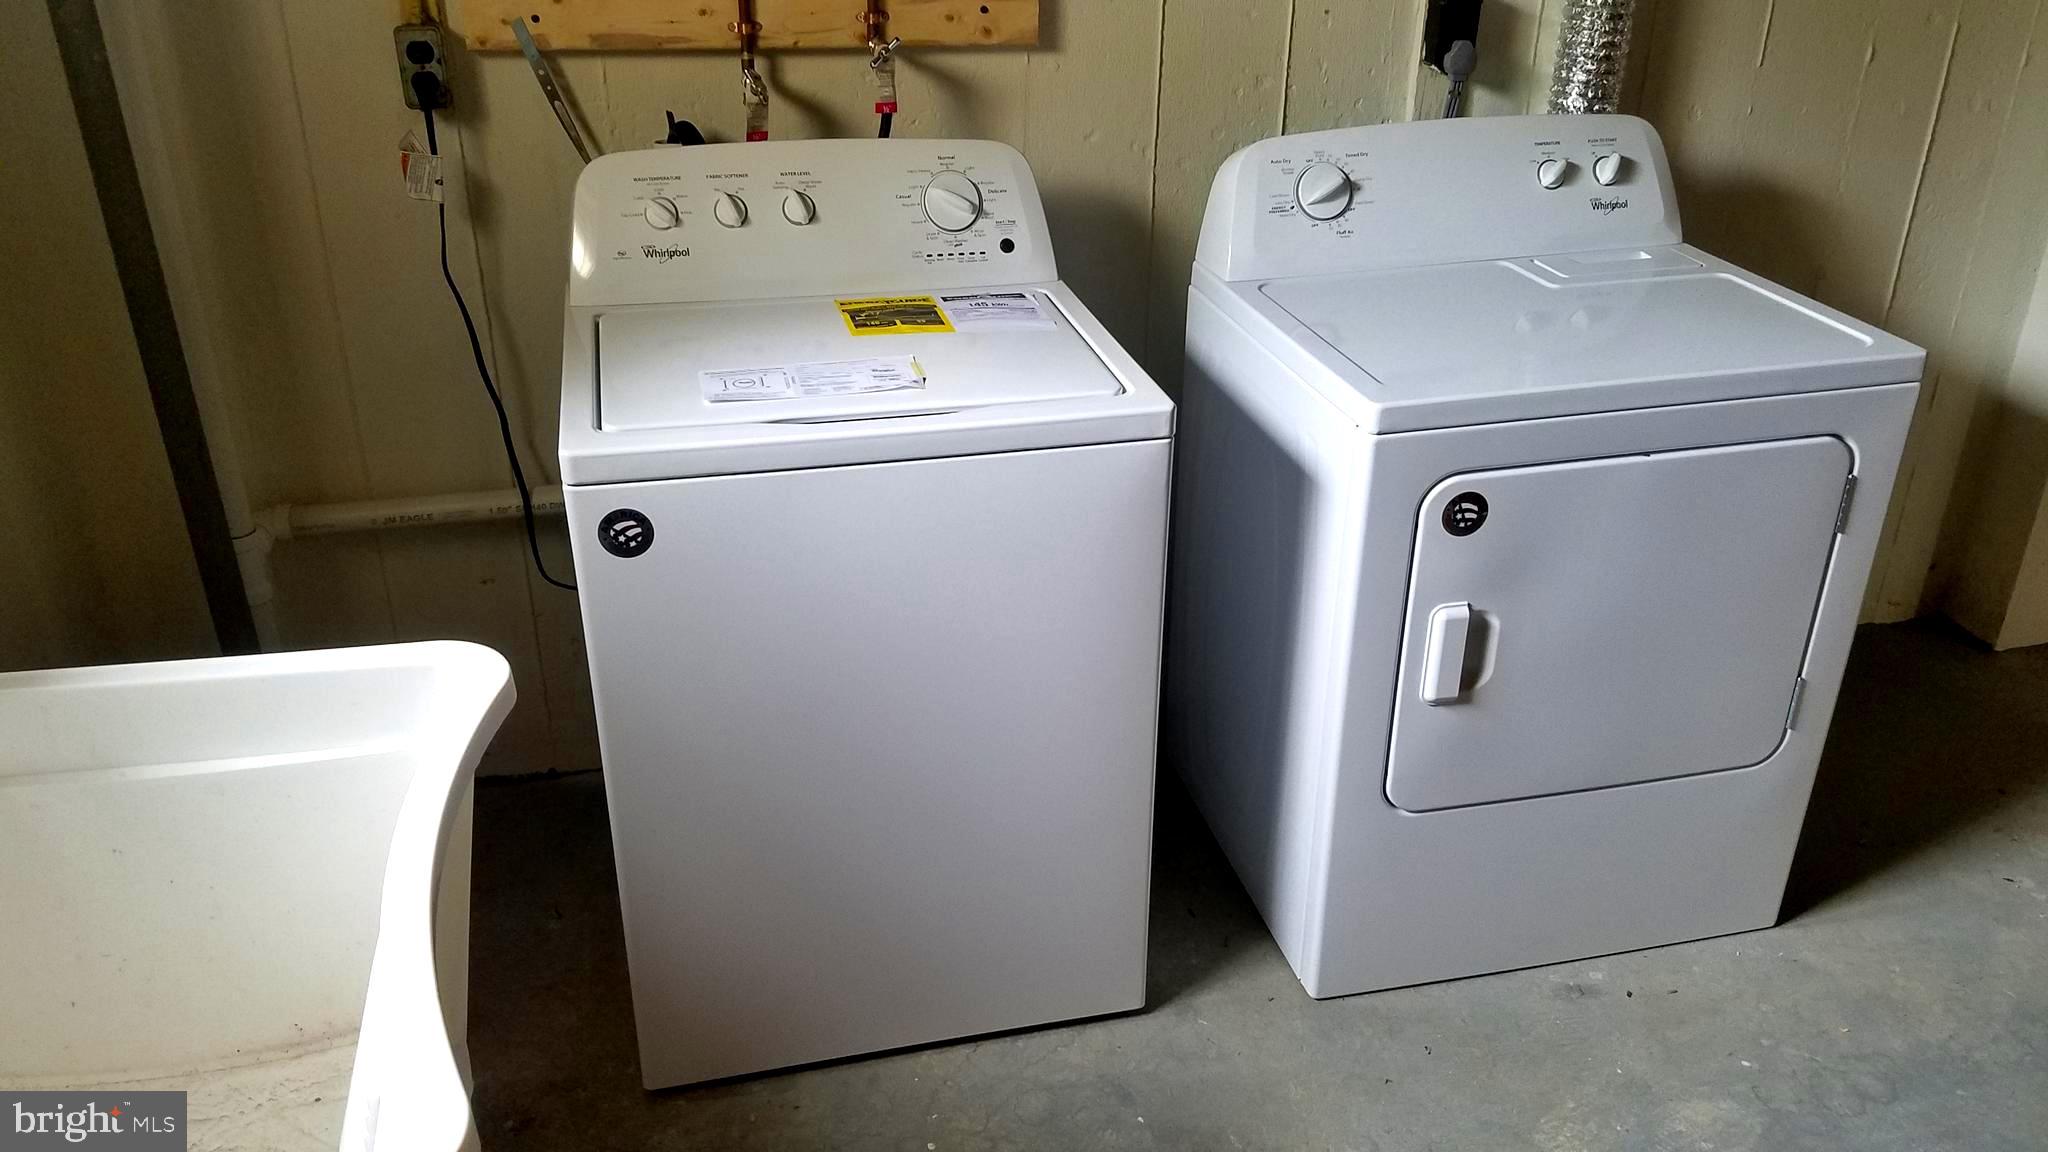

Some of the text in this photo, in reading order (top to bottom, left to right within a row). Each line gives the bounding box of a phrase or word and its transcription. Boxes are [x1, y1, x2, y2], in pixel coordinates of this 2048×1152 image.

[1591, 200, 1628, 212] Whirlpool
[641, 247, 690, 260] Whirlpool
[399, 512, 434, 523] EAGLE
